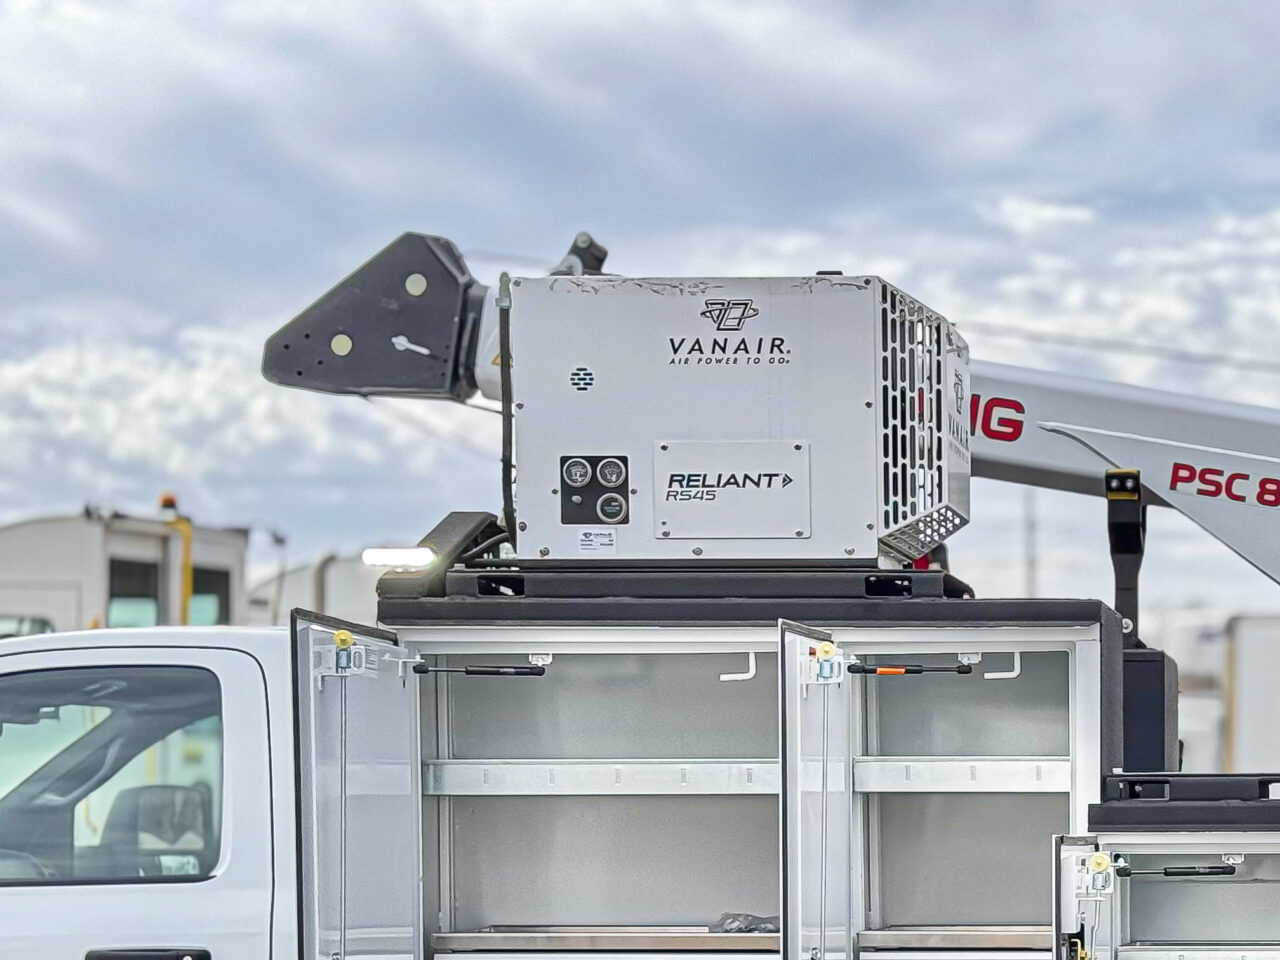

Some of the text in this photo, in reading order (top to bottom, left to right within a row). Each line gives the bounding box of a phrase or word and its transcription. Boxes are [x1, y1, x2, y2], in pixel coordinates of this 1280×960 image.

[696, 357, 738, 365] POWER
[746, 357, 761, 365] TO
[667, 473, 780, 489] RELIANT
[1169, 462, 1250, 503] PSC
[665, 489, 718, 501] RS45
